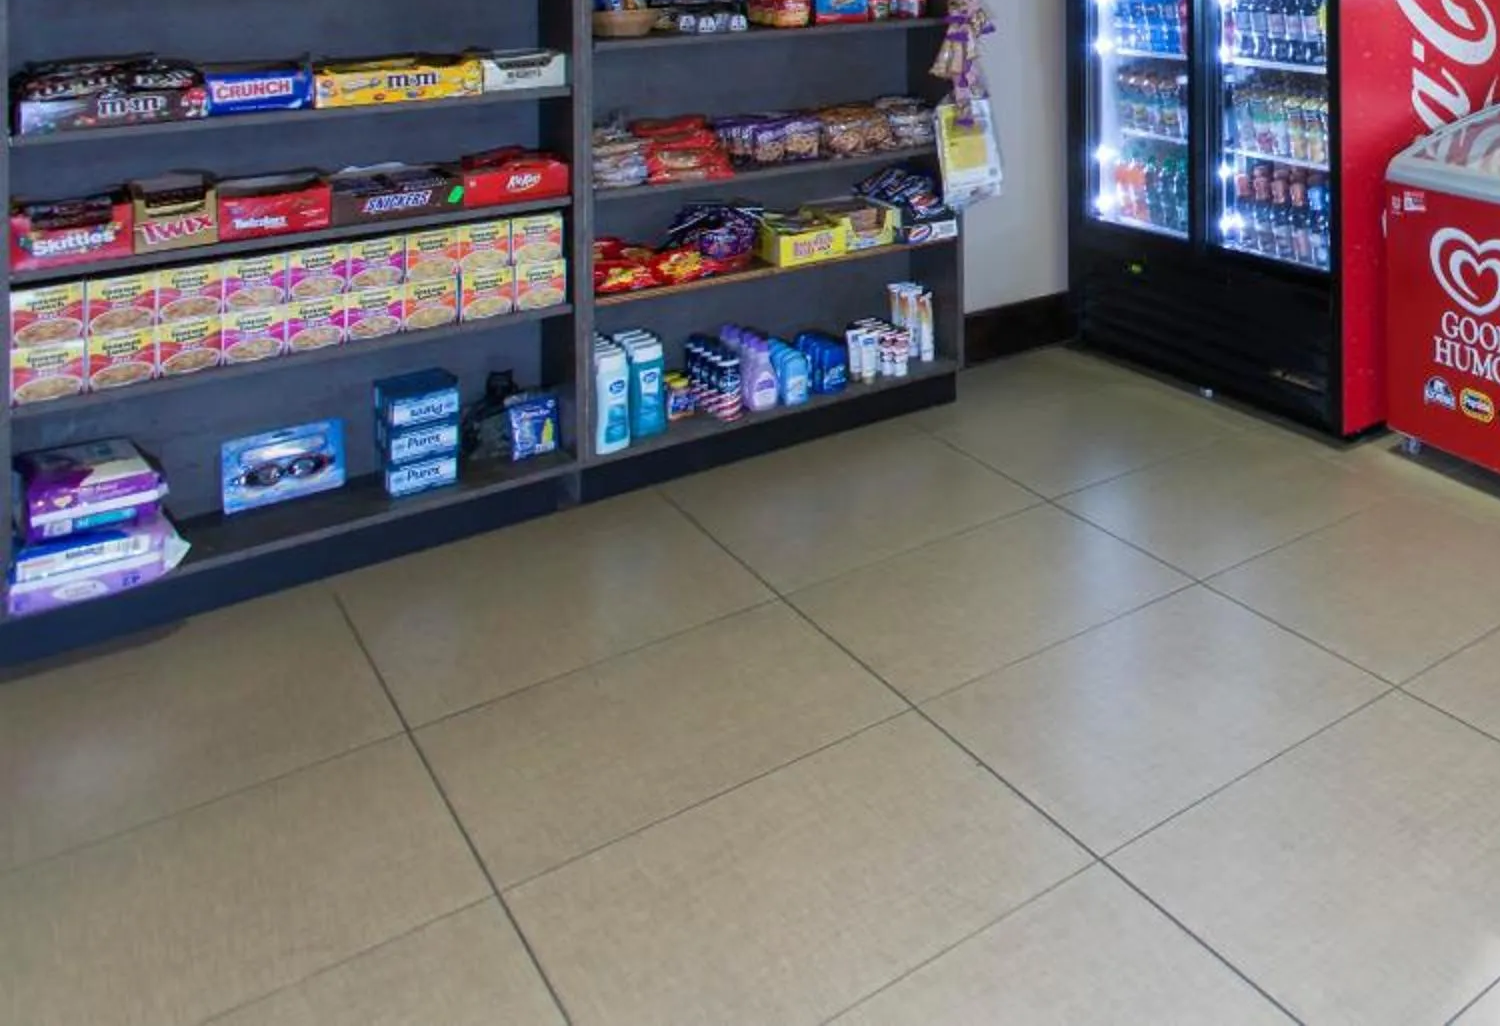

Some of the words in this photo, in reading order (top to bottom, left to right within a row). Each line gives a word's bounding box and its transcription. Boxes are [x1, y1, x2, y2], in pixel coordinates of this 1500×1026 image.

[214, 77, 293, 102] CRUNCH
[364, 188, 434, 214] SNICKERS
[31, 226, 117, 254] Skittles
